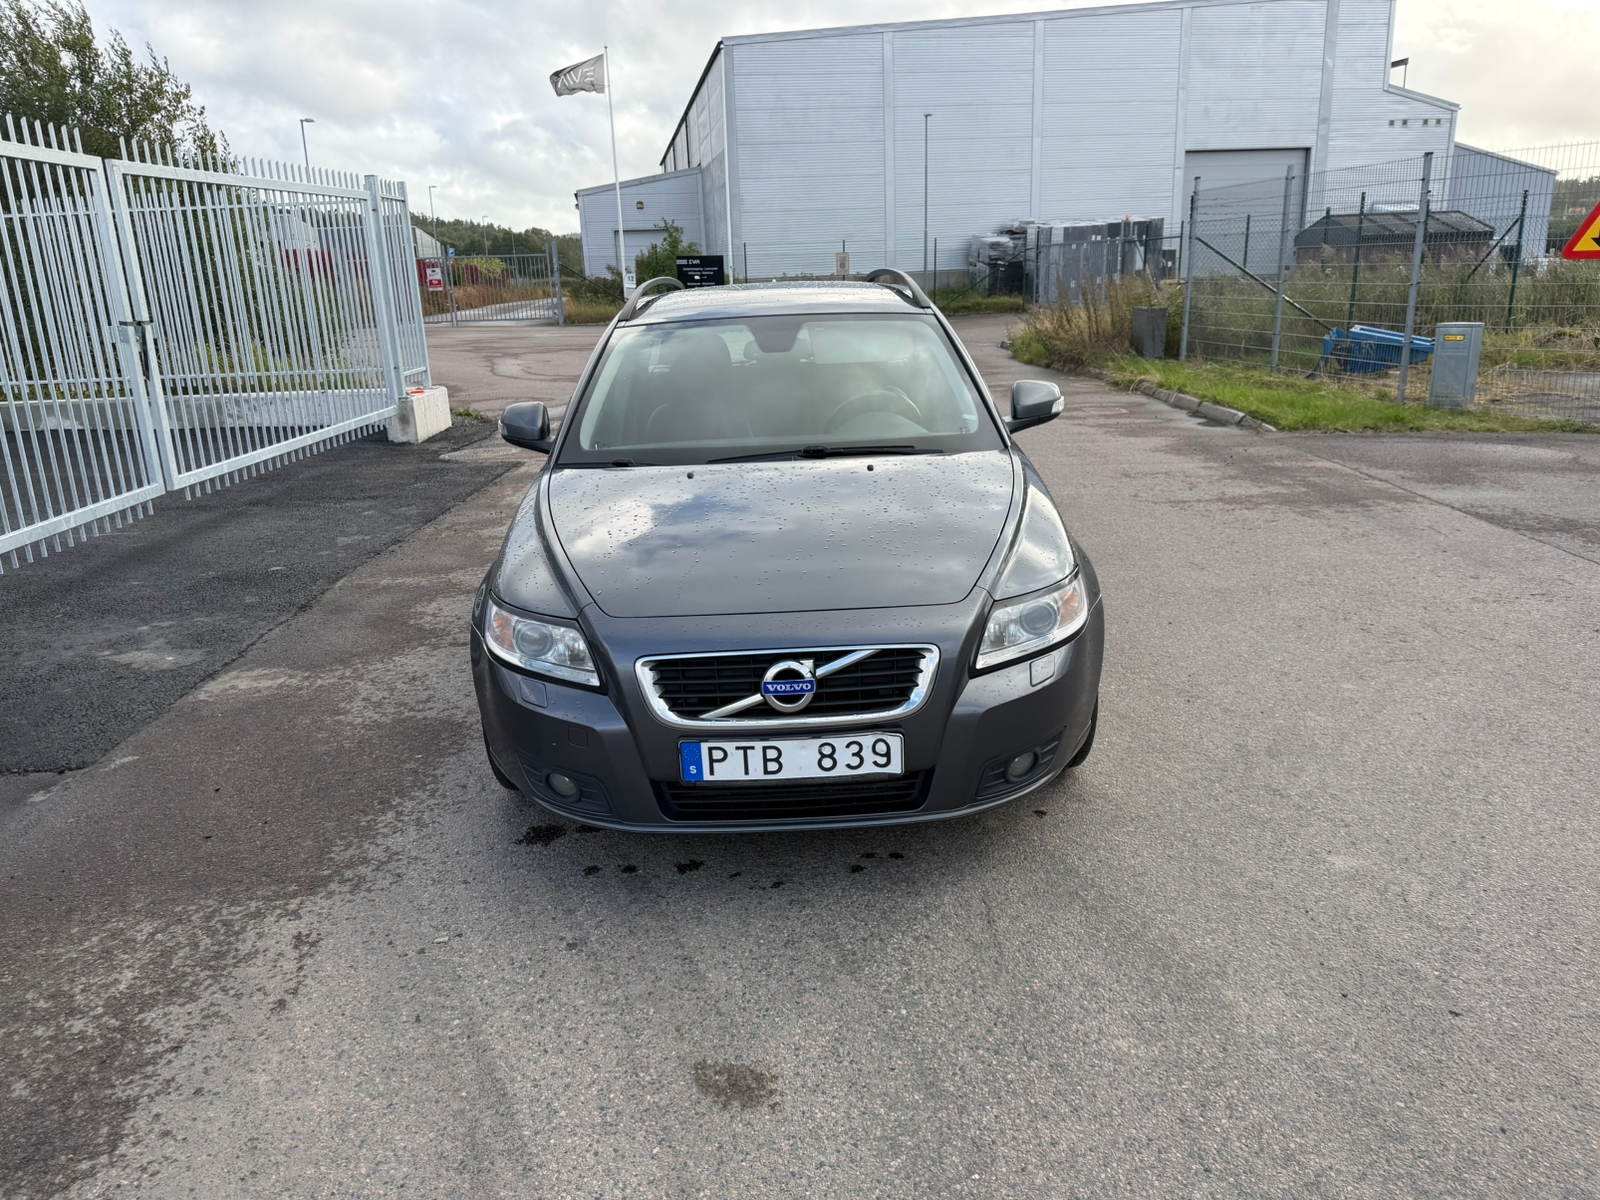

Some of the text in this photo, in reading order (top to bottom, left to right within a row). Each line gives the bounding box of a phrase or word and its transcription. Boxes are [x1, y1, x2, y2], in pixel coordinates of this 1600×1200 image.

[766, 683, 811, 692] VOLVO
[707, 738, 892, 776] PTB 839
[689, 765, 697, 774] S
